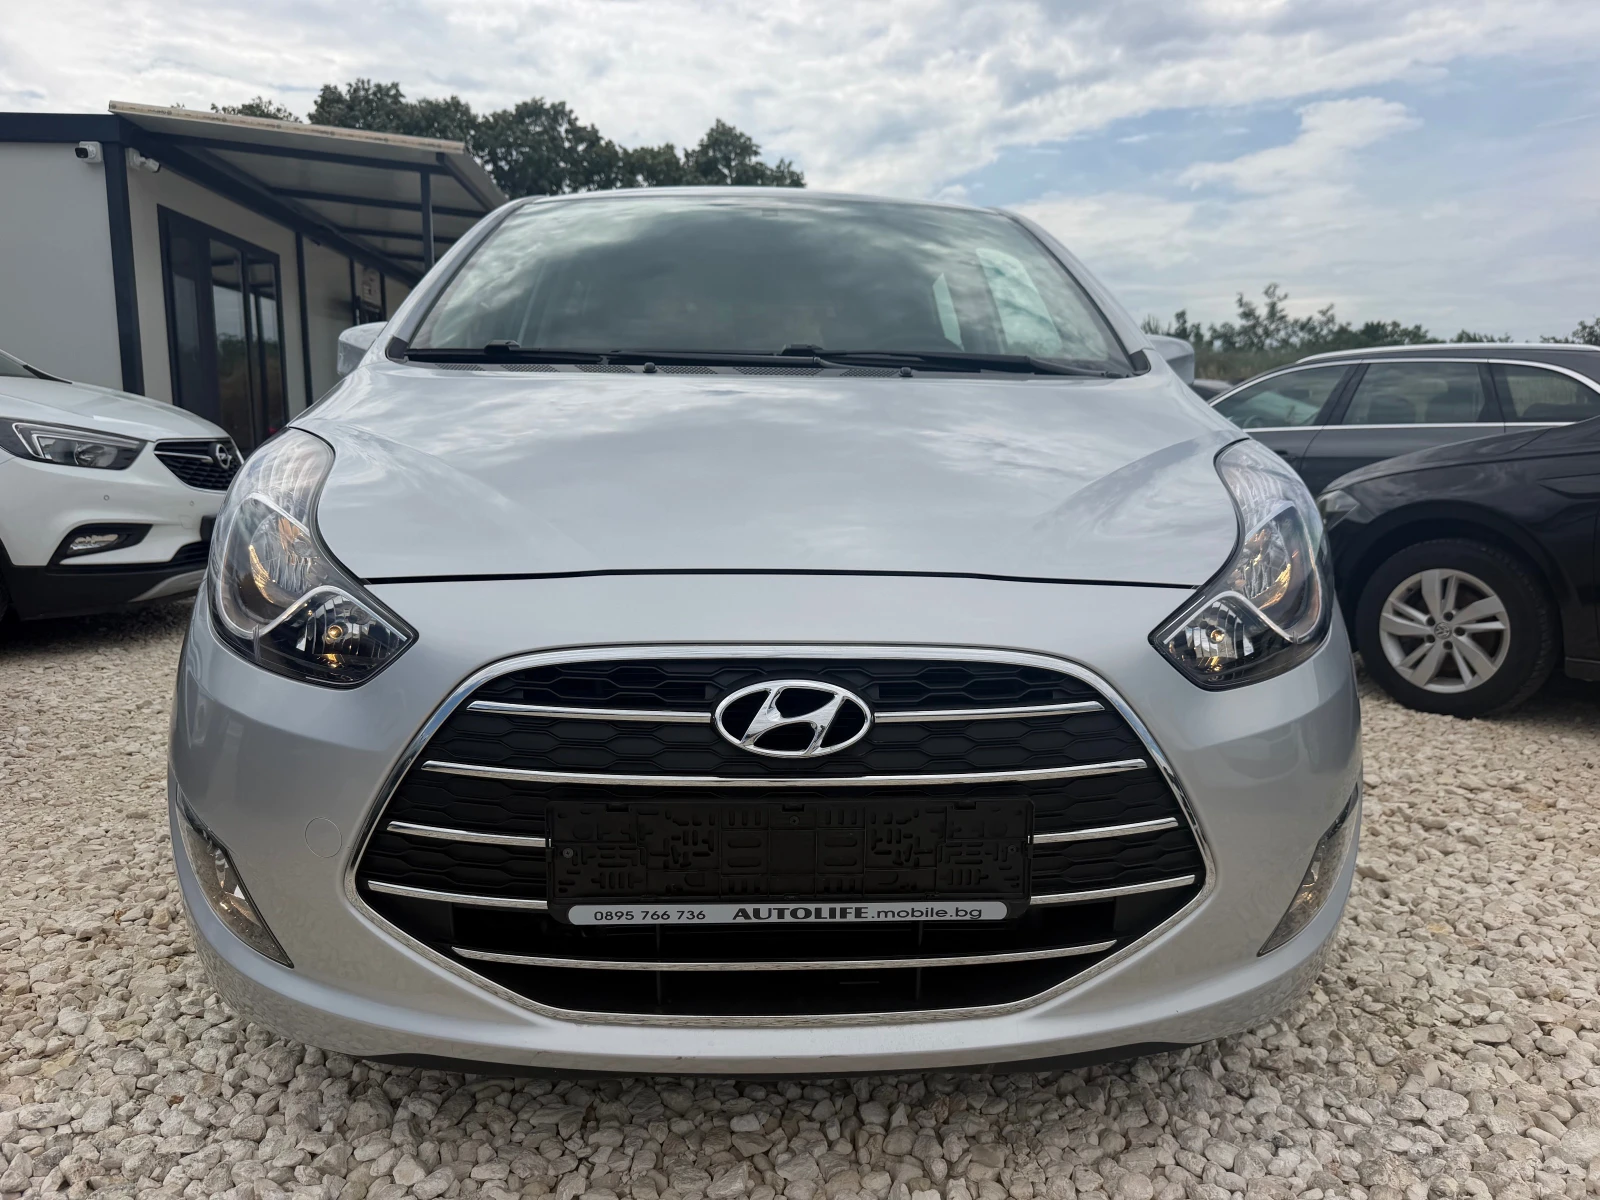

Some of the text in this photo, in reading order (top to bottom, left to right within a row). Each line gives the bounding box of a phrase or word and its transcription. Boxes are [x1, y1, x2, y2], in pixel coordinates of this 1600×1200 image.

[593, 910, 706, 921] 0895 766 736
